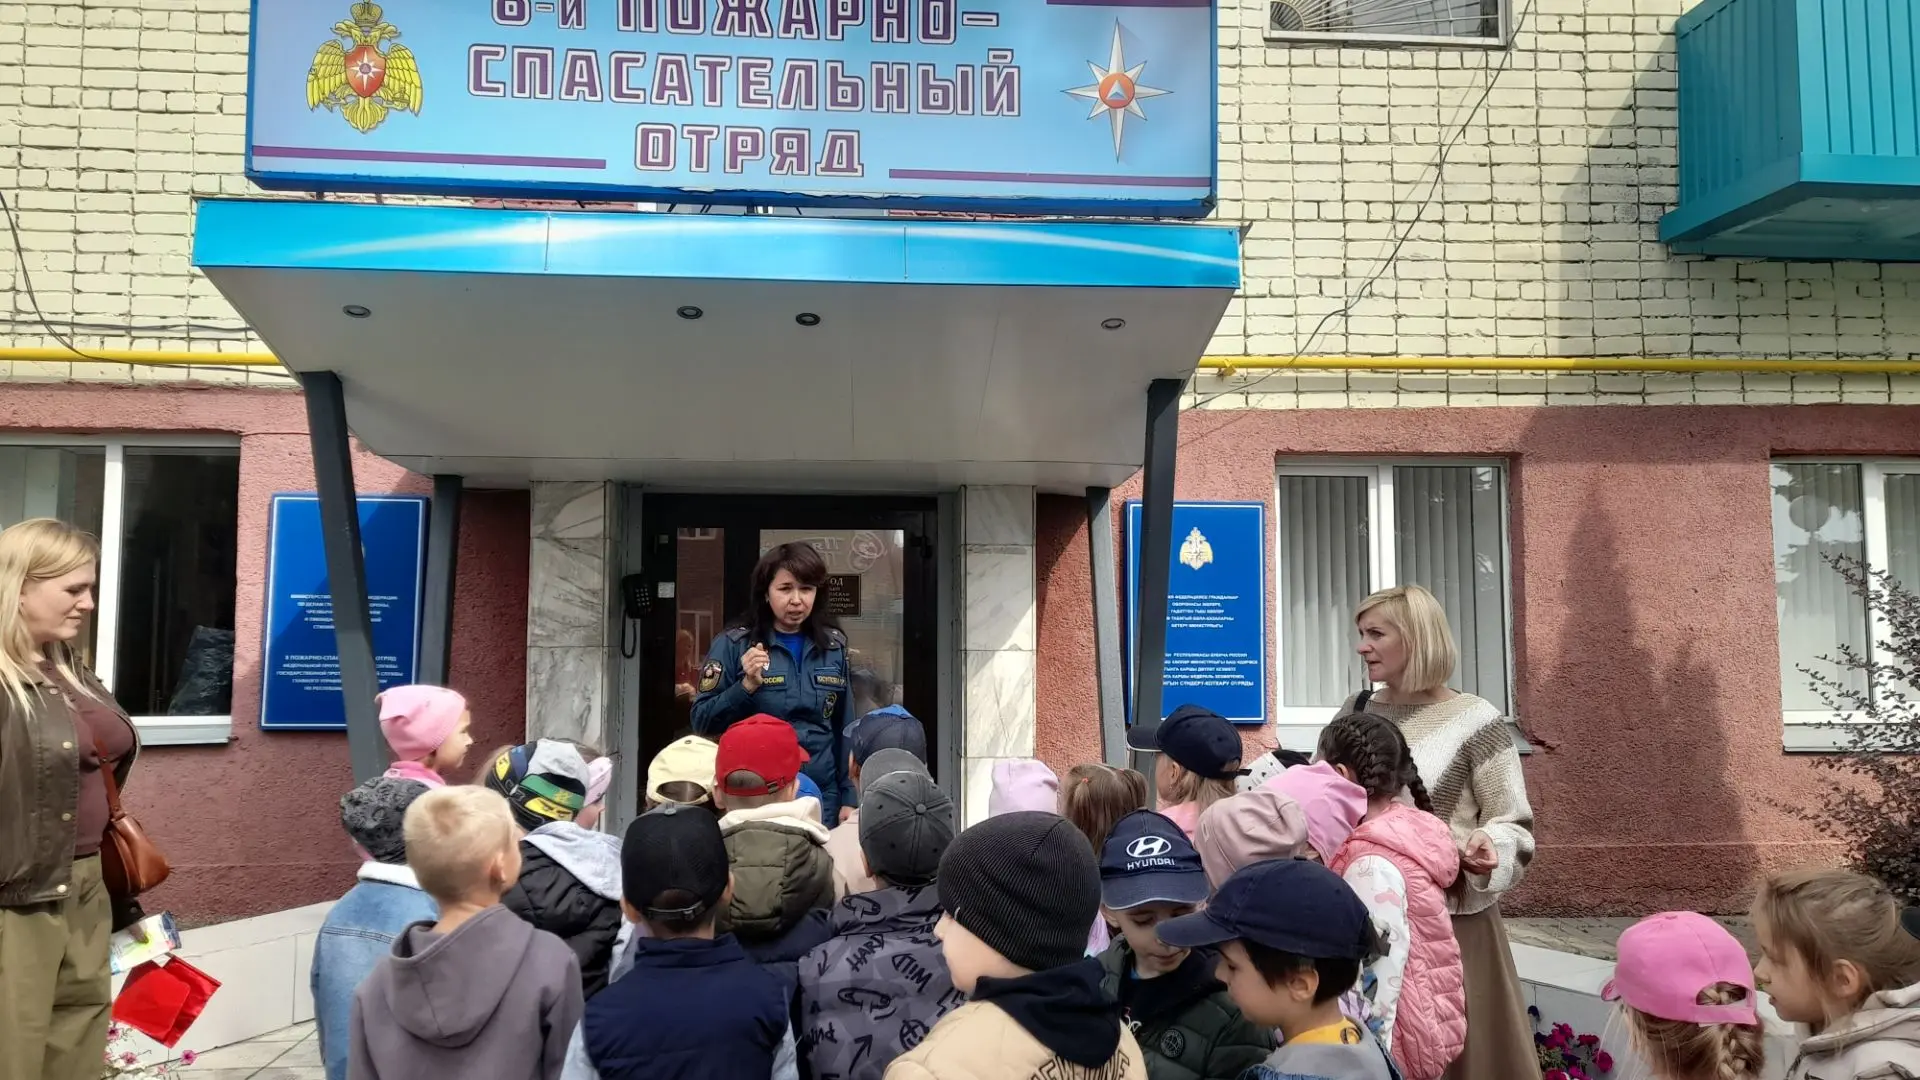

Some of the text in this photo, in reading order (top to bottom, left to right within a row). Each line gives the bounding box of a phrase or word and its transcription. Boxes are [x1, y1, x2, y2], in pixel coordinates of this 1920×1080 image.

[468, 43, 1020, 117] СПАСАТЕЛЬНЫЙ
[634, 122, 865, 178] ОТРЯД
[1127, 857, 1176, 871] HYUNDAI
[845, 933, 885, 973] HARD
